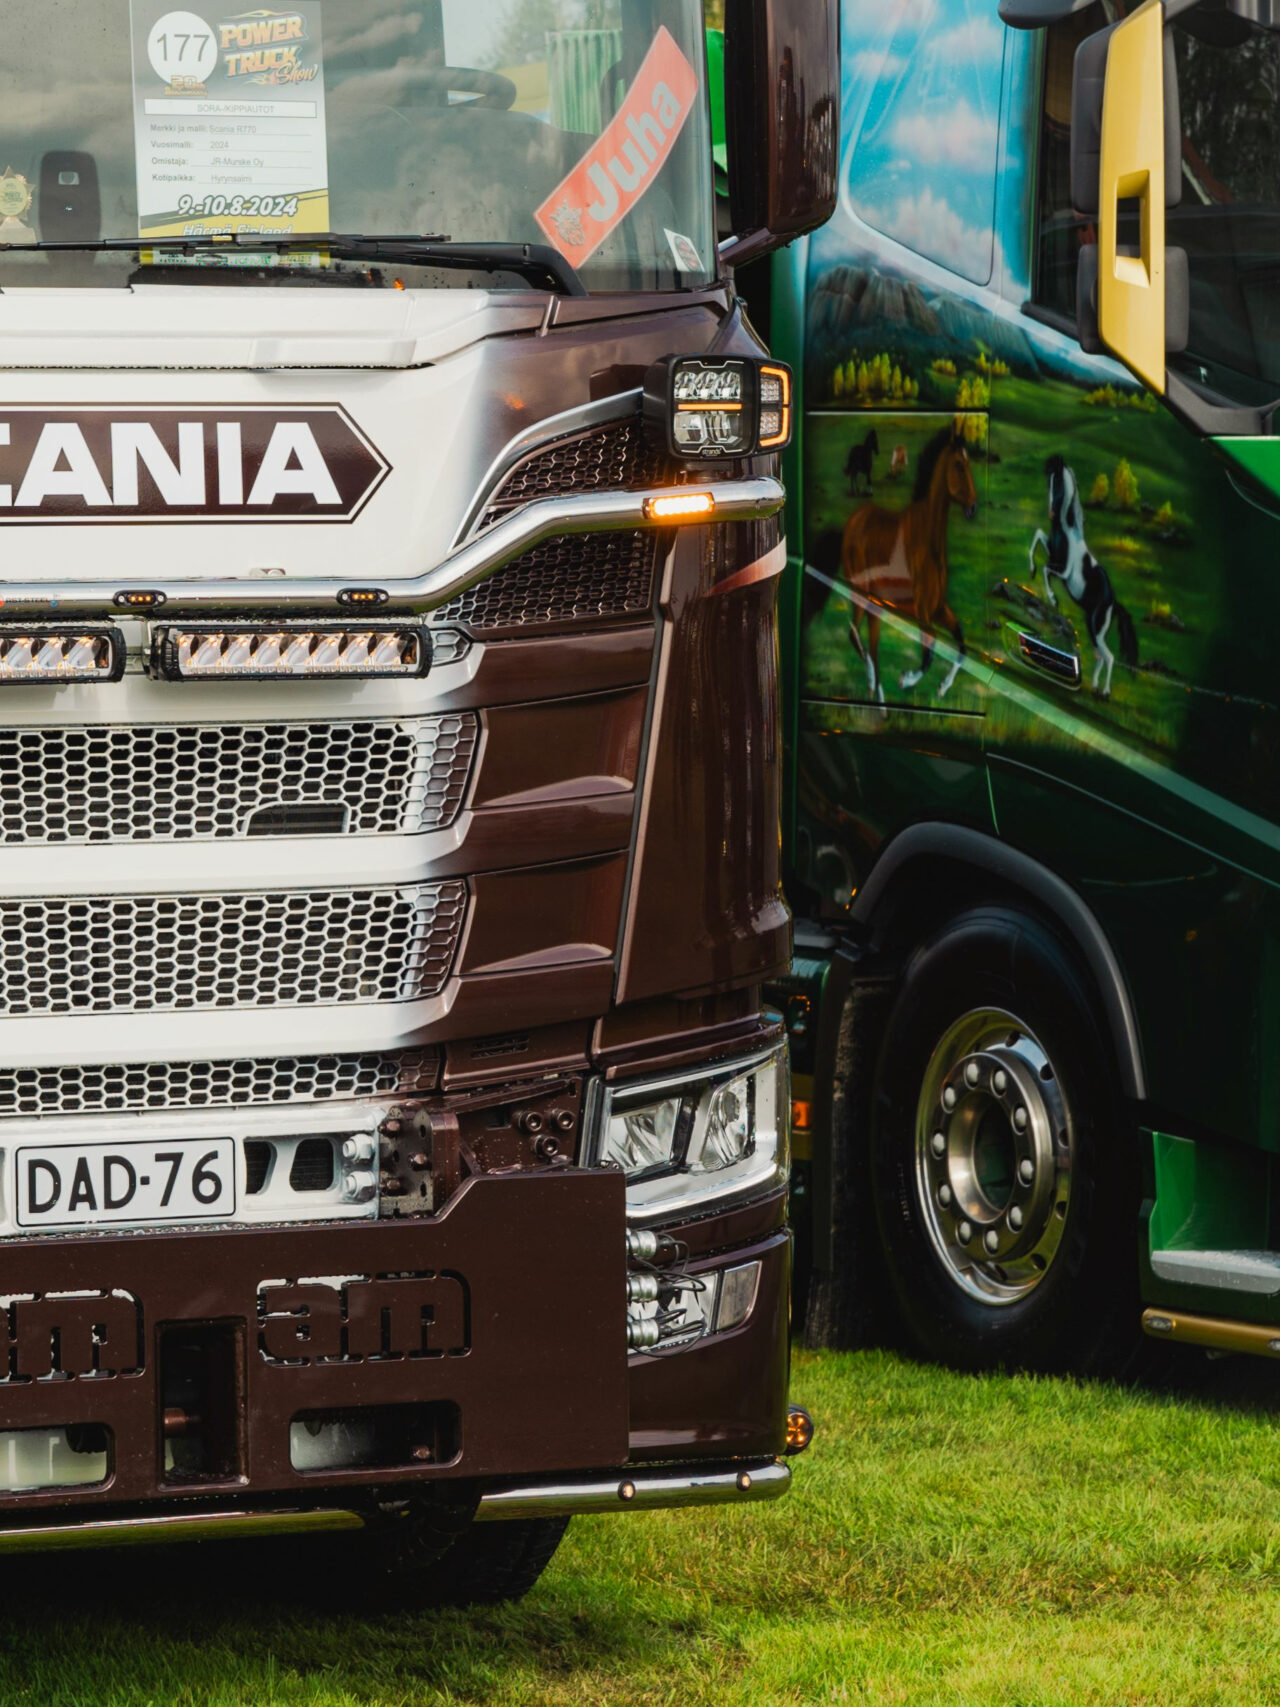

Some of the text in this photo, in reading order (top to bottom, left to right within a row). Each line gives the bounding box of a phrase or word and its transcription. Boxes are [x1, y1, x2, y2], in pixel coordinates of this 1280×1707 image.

[219, 15, 304, 49] POWER
[156, 33, 211, 62] 177
[224, 45, 301, 77] TRUCK
[277, 60, 319, 85] Show
[150, 123, 176, 133] Merkki
[178, 124, 186, 134] ja
[209, 124, 235, 134] Scania
[236, 125, 257, 134] R770
[150, 140, 229, 149] Vuosimalli: 2024
[586, 81, 682, 222] Juha
[151, 156, 188, 167] Omistaja:
[253, 158, 264, 168] Oy
[152, 174, 195, 184] Kotipaikka:
[178, 194, 299, 217] 9.-10.8.2024
[27, 1149, 223, 1214] DAD-76
